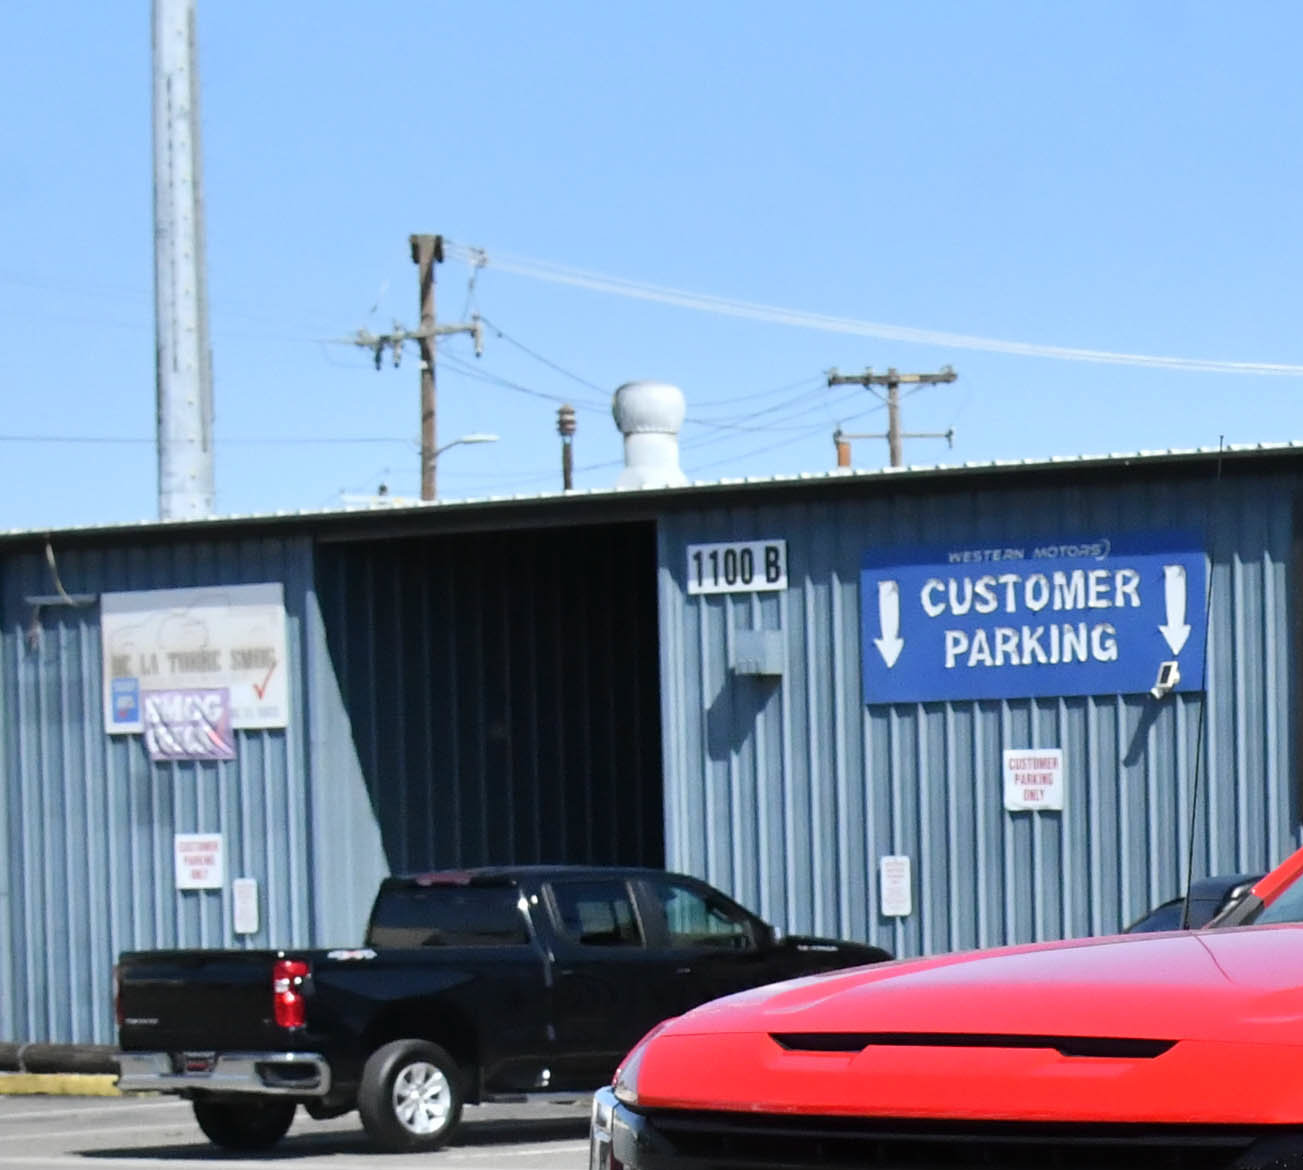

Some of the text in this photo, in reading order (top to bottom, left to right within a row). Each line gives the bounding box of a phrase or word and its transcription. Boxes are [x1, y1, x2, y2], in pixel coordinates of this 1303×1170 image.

[693, 545, 781, 588] 1100 B
[948, 543, 1102, 563] WESTERN MOTORS
[920, 568, 1142, 618] CUSTOMER
[944, 622, 1119, 669] PARKING
